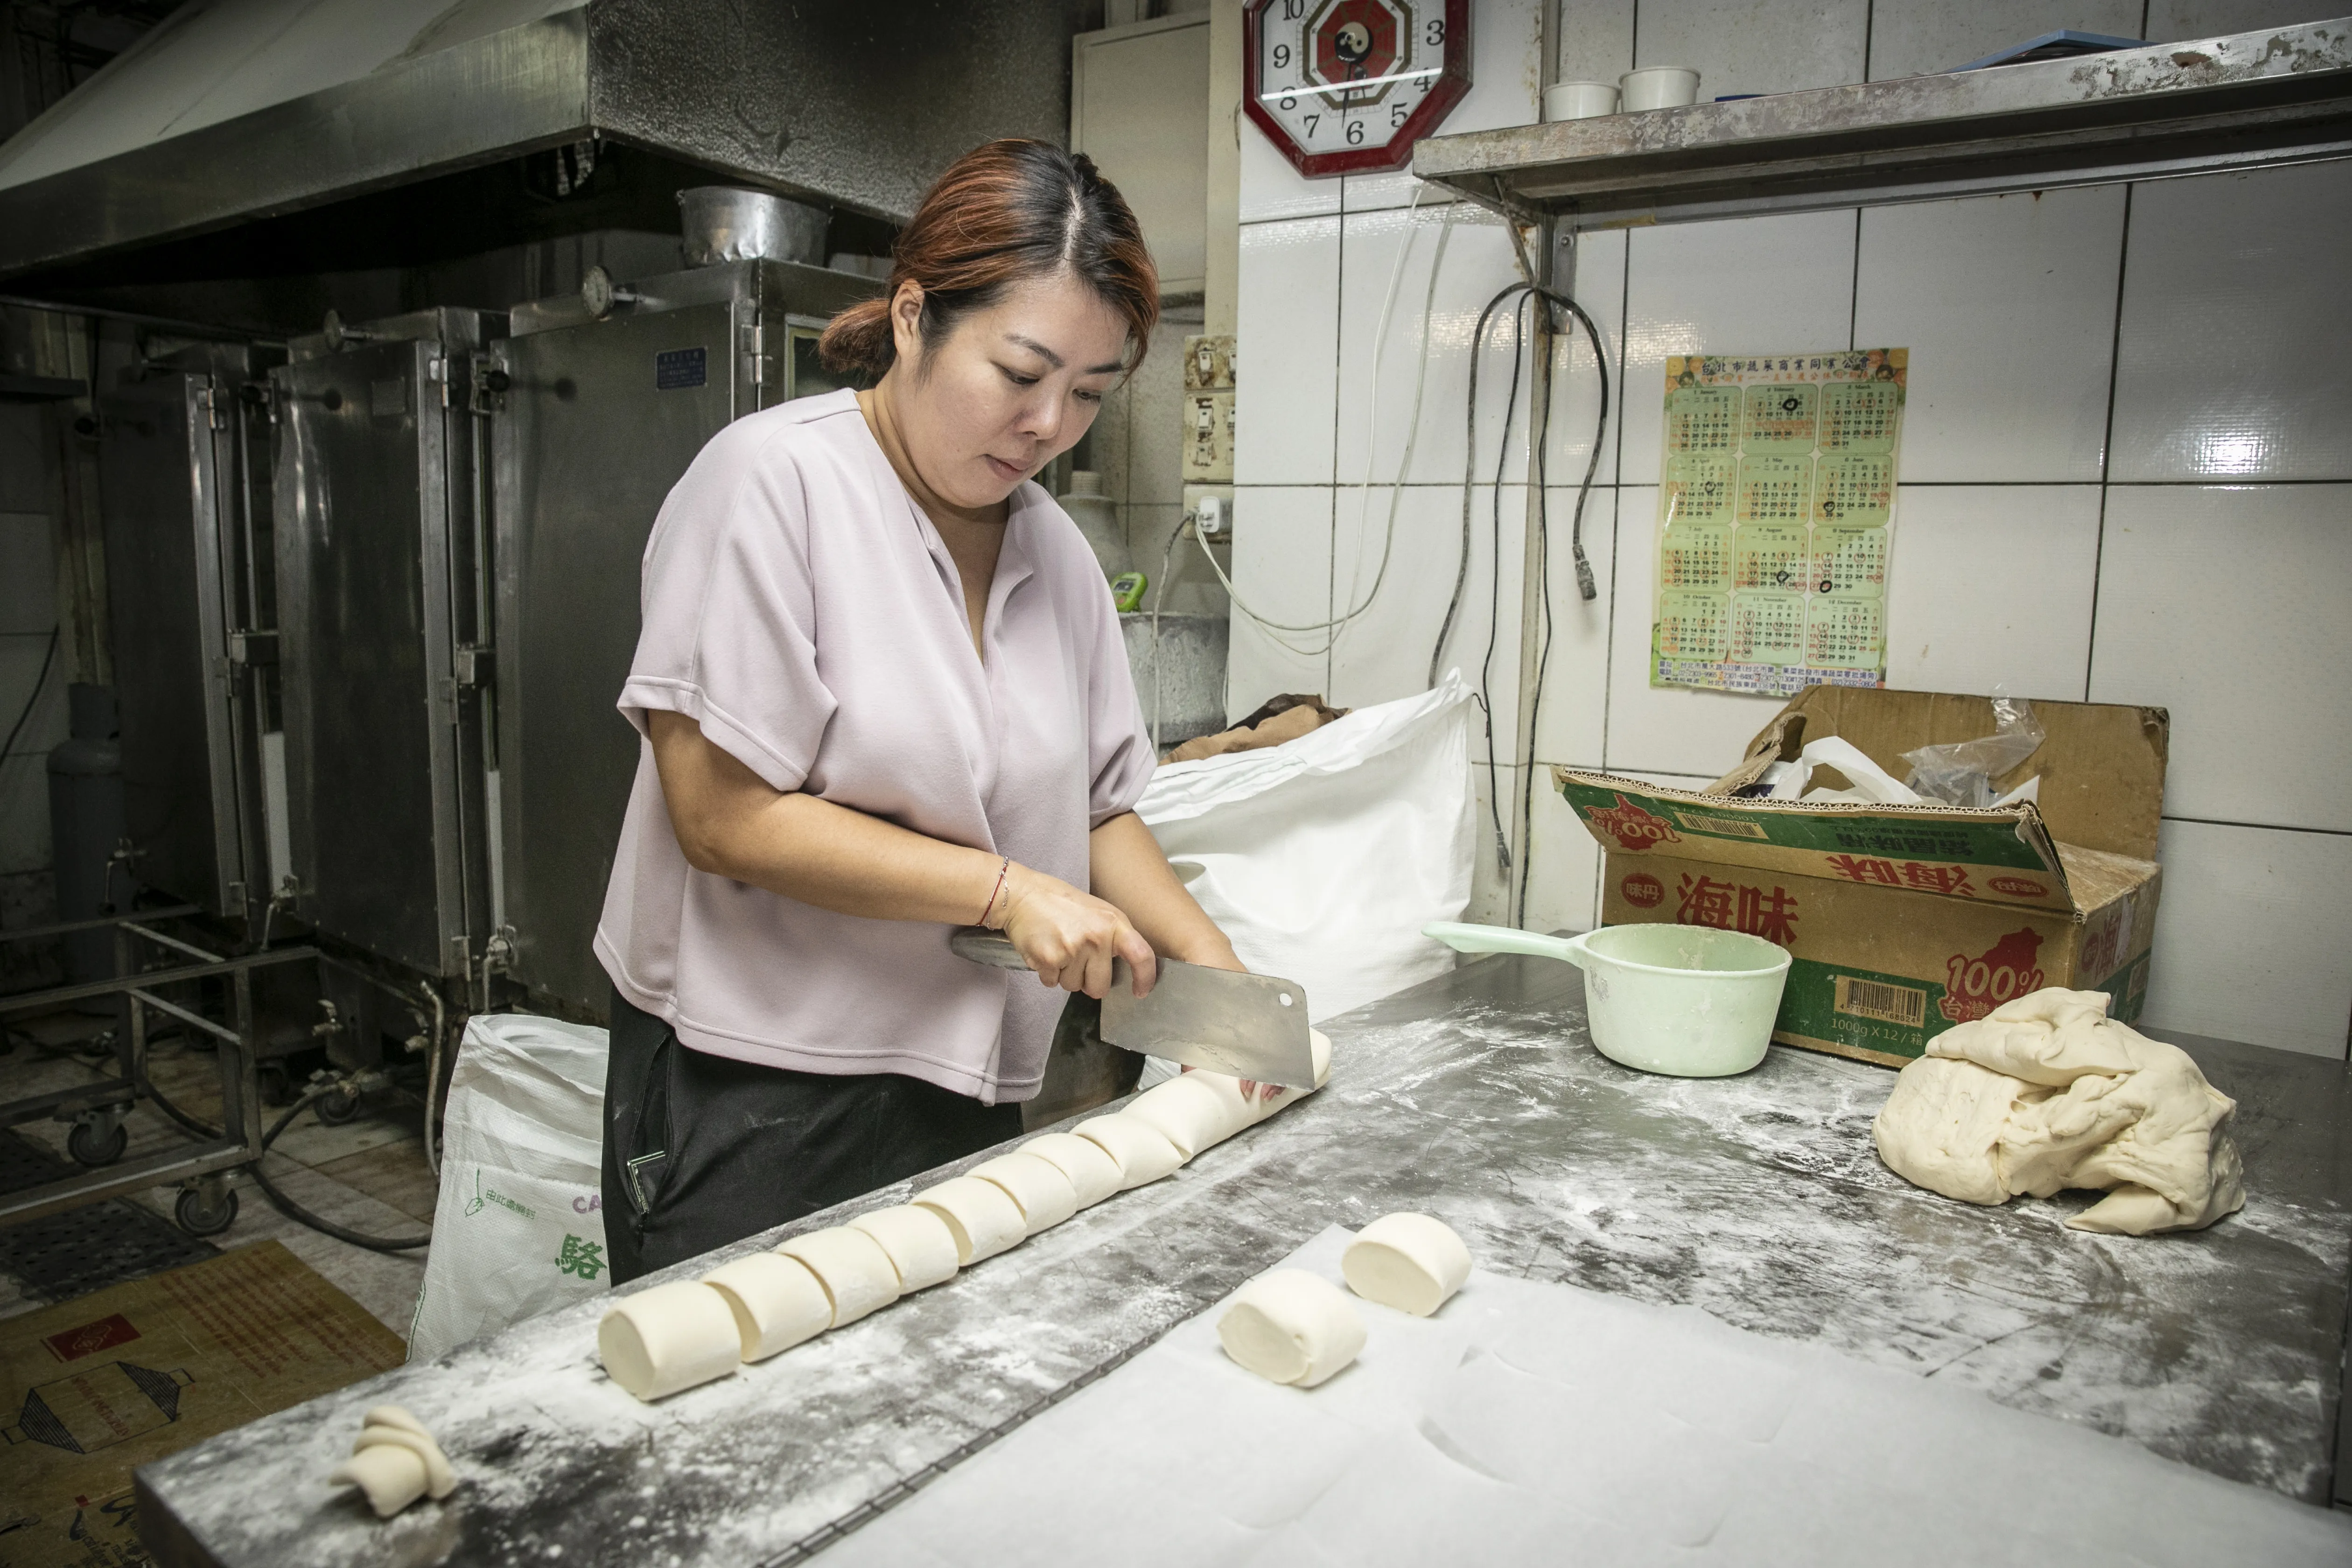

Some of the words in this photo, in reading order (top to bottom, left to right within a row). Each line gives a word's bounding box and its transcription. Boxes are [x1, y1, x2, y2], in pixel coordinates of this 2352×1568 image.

[1283, 0, 1303, 20] 10
[1427, 20, 1444, 45] 3
[1274, 44, 1290, 68] 9
[1414, 68, 1431, 91] 4
[1280, 87, 1297, 110] 8
[1304, 114, 1320, 138] 7
[1391, 103, 1407, 127] 5
[1346, 121, 1364, 145] 6
[1596, 817, 1680, 842] 100%
[1826, 855, 1977, 897] 海味
[1995, 881, 2041, 892] 味丹
[1626, 882, 1660, 900] 味丹
[1677, 872, 1799, 945] 海味
[1948, 955, 2042, 1001] 100%
[1850, 1006, 1880, 1016] 710111
[1886, 1013, 1916, 1023] 168624
[1832, 1018, 1868, 1037] 1000g
[1871, 1026, 1880, 1037] X
[1883, 1029, 1898, 1041] 12
[573, 1195, 602, 1214] CA
[554, 1233, 607, 1280] 駱
